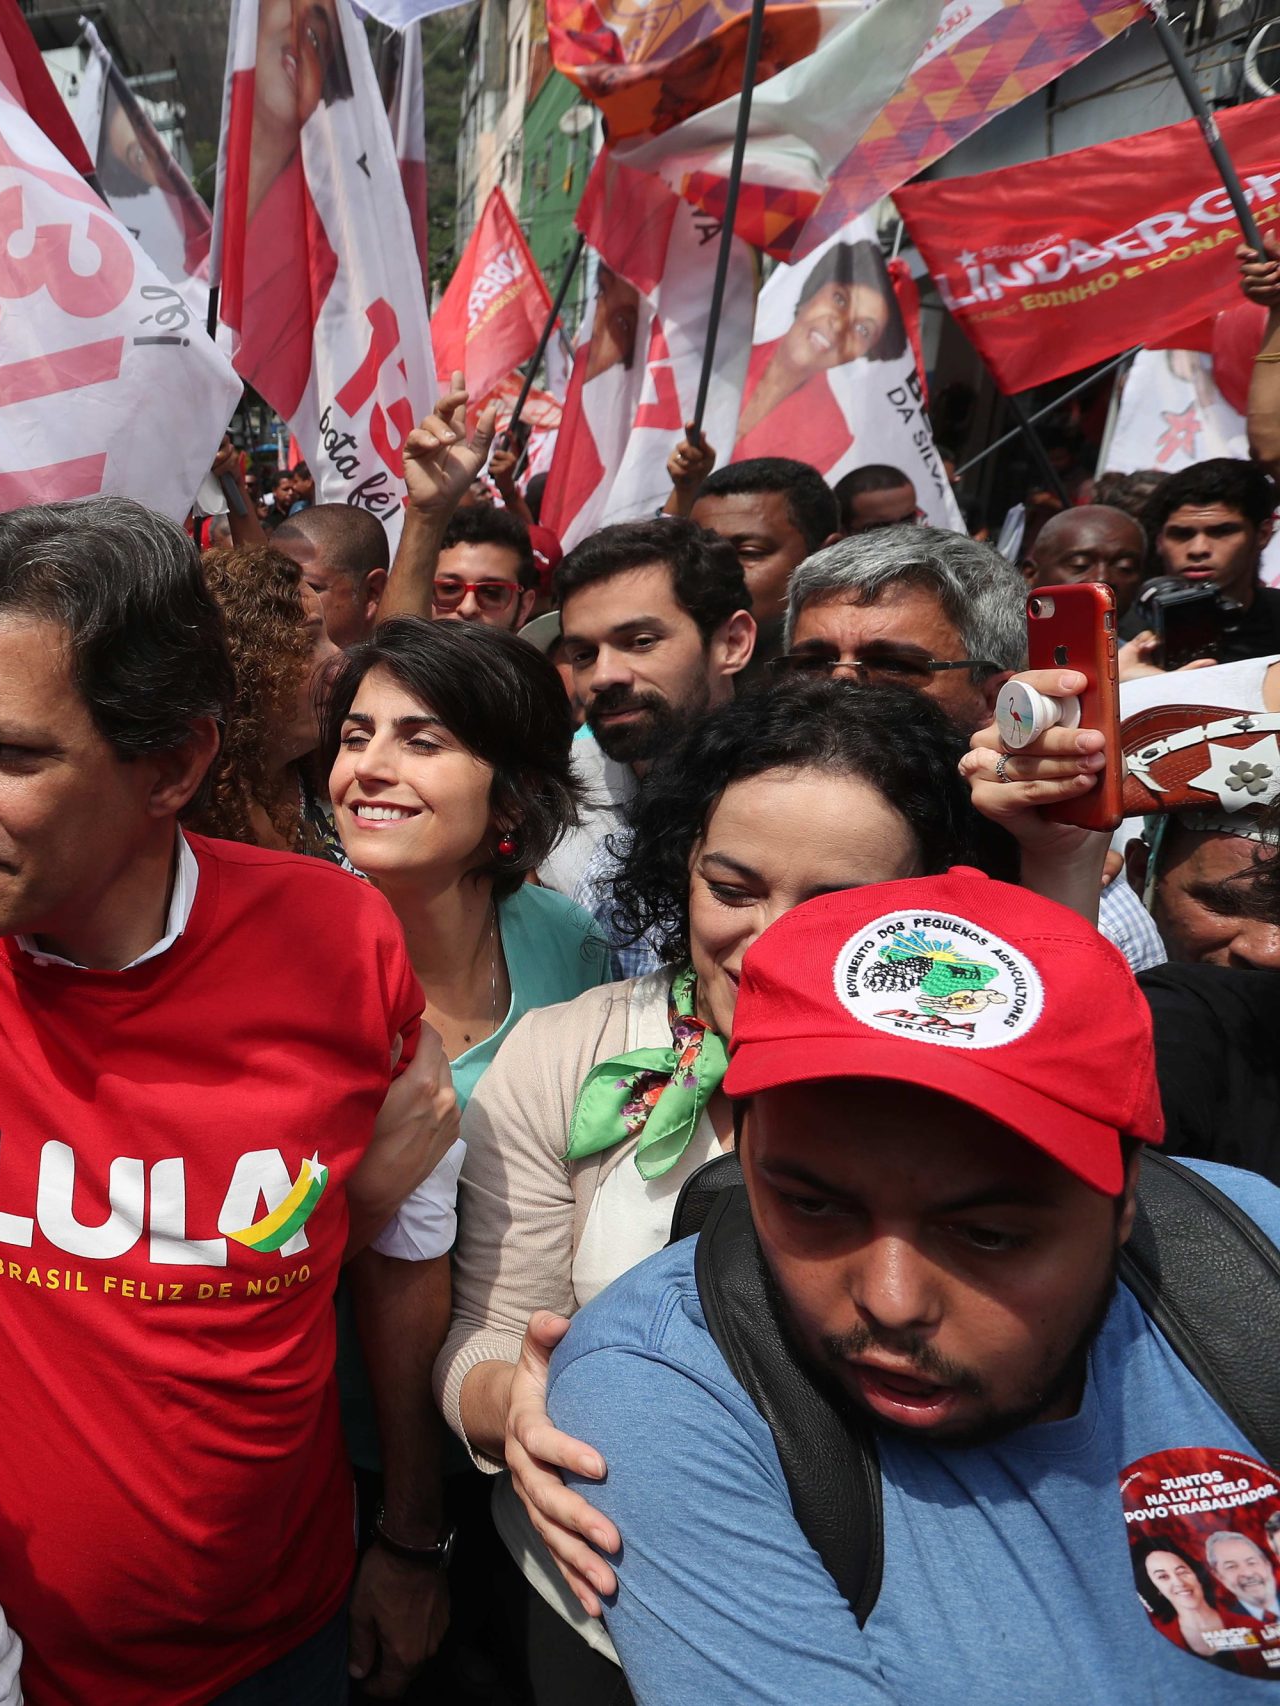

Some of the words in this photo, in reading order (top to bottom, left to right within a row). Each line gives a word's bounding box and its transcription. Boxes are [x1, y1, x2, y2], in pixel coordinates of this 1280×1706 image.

[887, 387, 915, 424] DA
[320, 405, 362, 481] bota
[846, 940, 875, 998] MOVIMENTO
[877, 921, 906, 940] DOS
[913, 917, 989, 947] PEQUENOS
[990, 948, 1028, 1028] AGRICULTORES
[894, 1021, 951, 1038] BRASIL
[103, 1276, 184, 1301] FELIZ
[197, 1282, 232, 1300] DE
[246, 1264, 311, 1297] NOVO
[1145, 1493, 1170, 1506] NA
[1170, 1484, 1212, 1502] LUTA
[1212, 1478, 1250, 1497] PELO
[1160, 1470, 1224, 1491] JUNTOS
[1123, 1505, 1169, 1523] POVO
